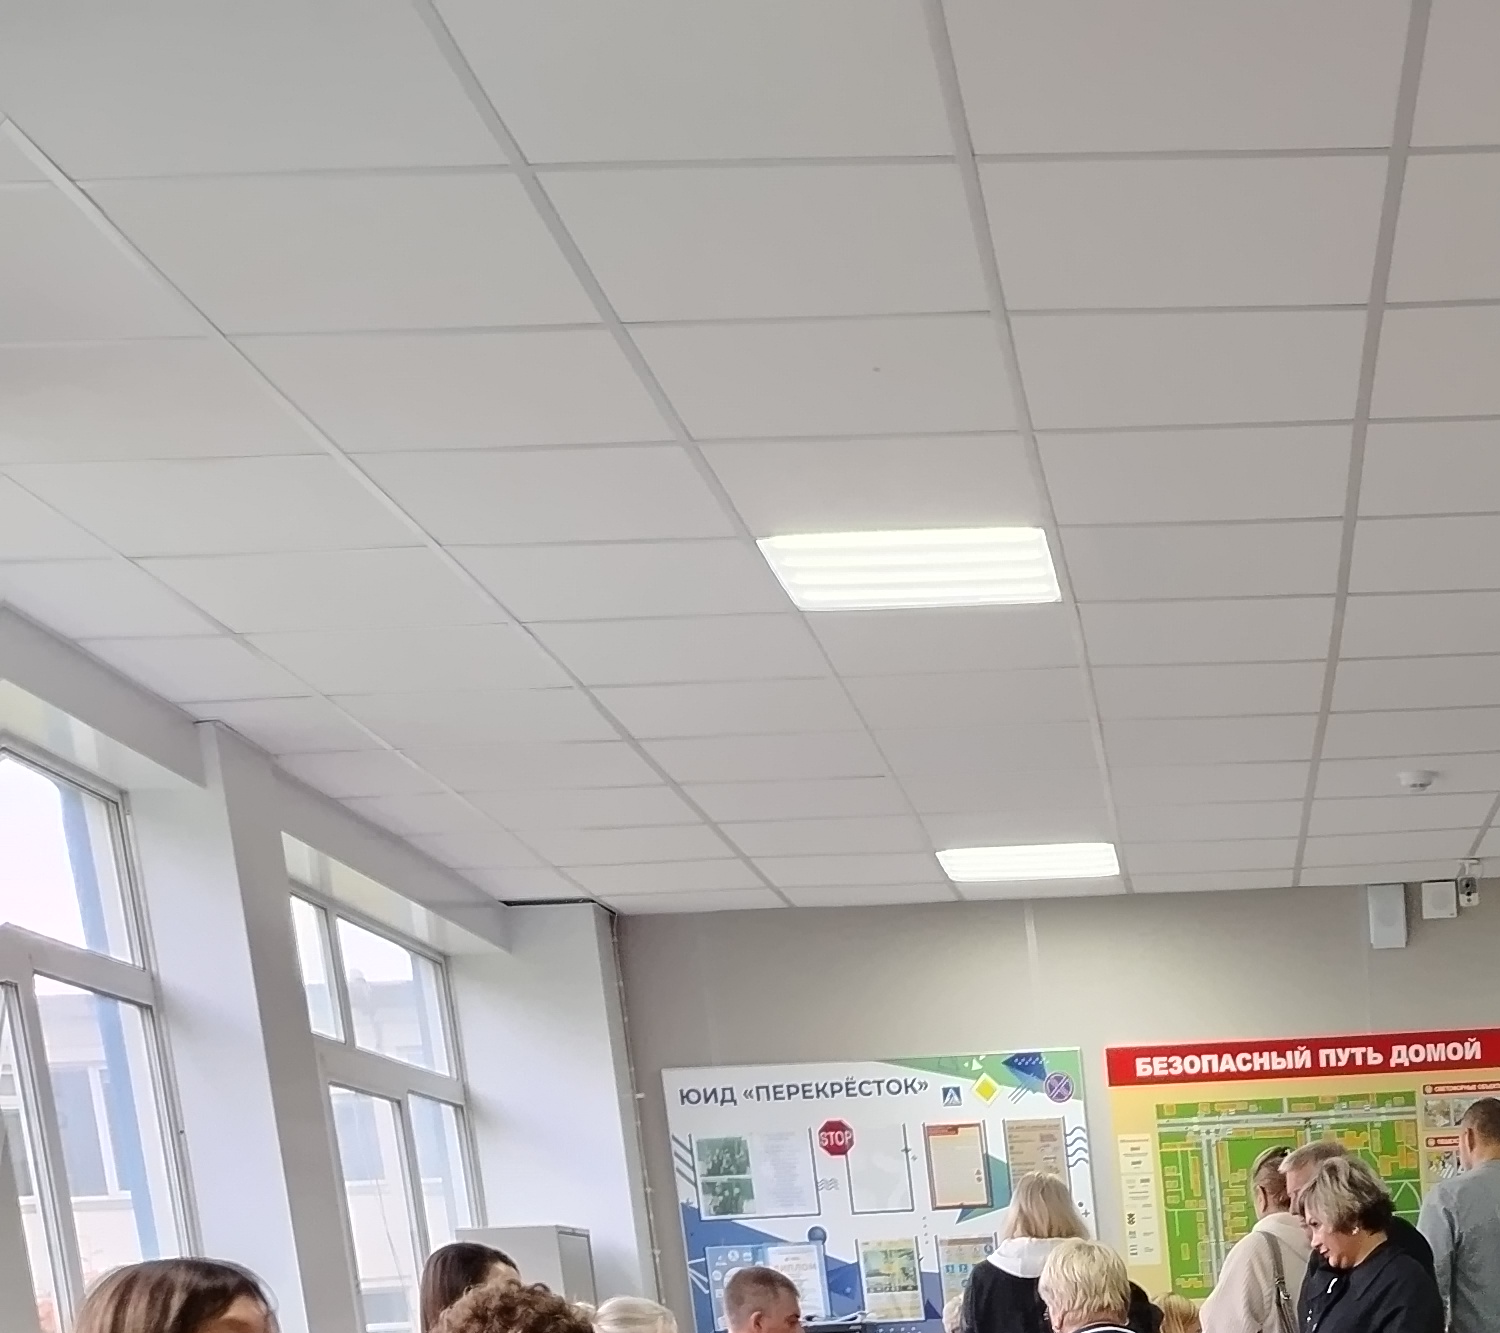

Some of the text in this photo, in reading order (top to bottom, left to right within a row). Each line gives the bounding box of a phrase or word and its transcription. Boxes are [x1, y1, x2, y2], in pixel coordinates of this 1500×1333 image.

[1135, 1037, 1481, 1077] БЕЗОПАСНЫЙ ПУТЬ ДОМОЙ
[679, 1076, 929, 1107] ЮИД «ПЕРЕКРЁСТОК»
[819, 1129, 852, 1147] STOP
